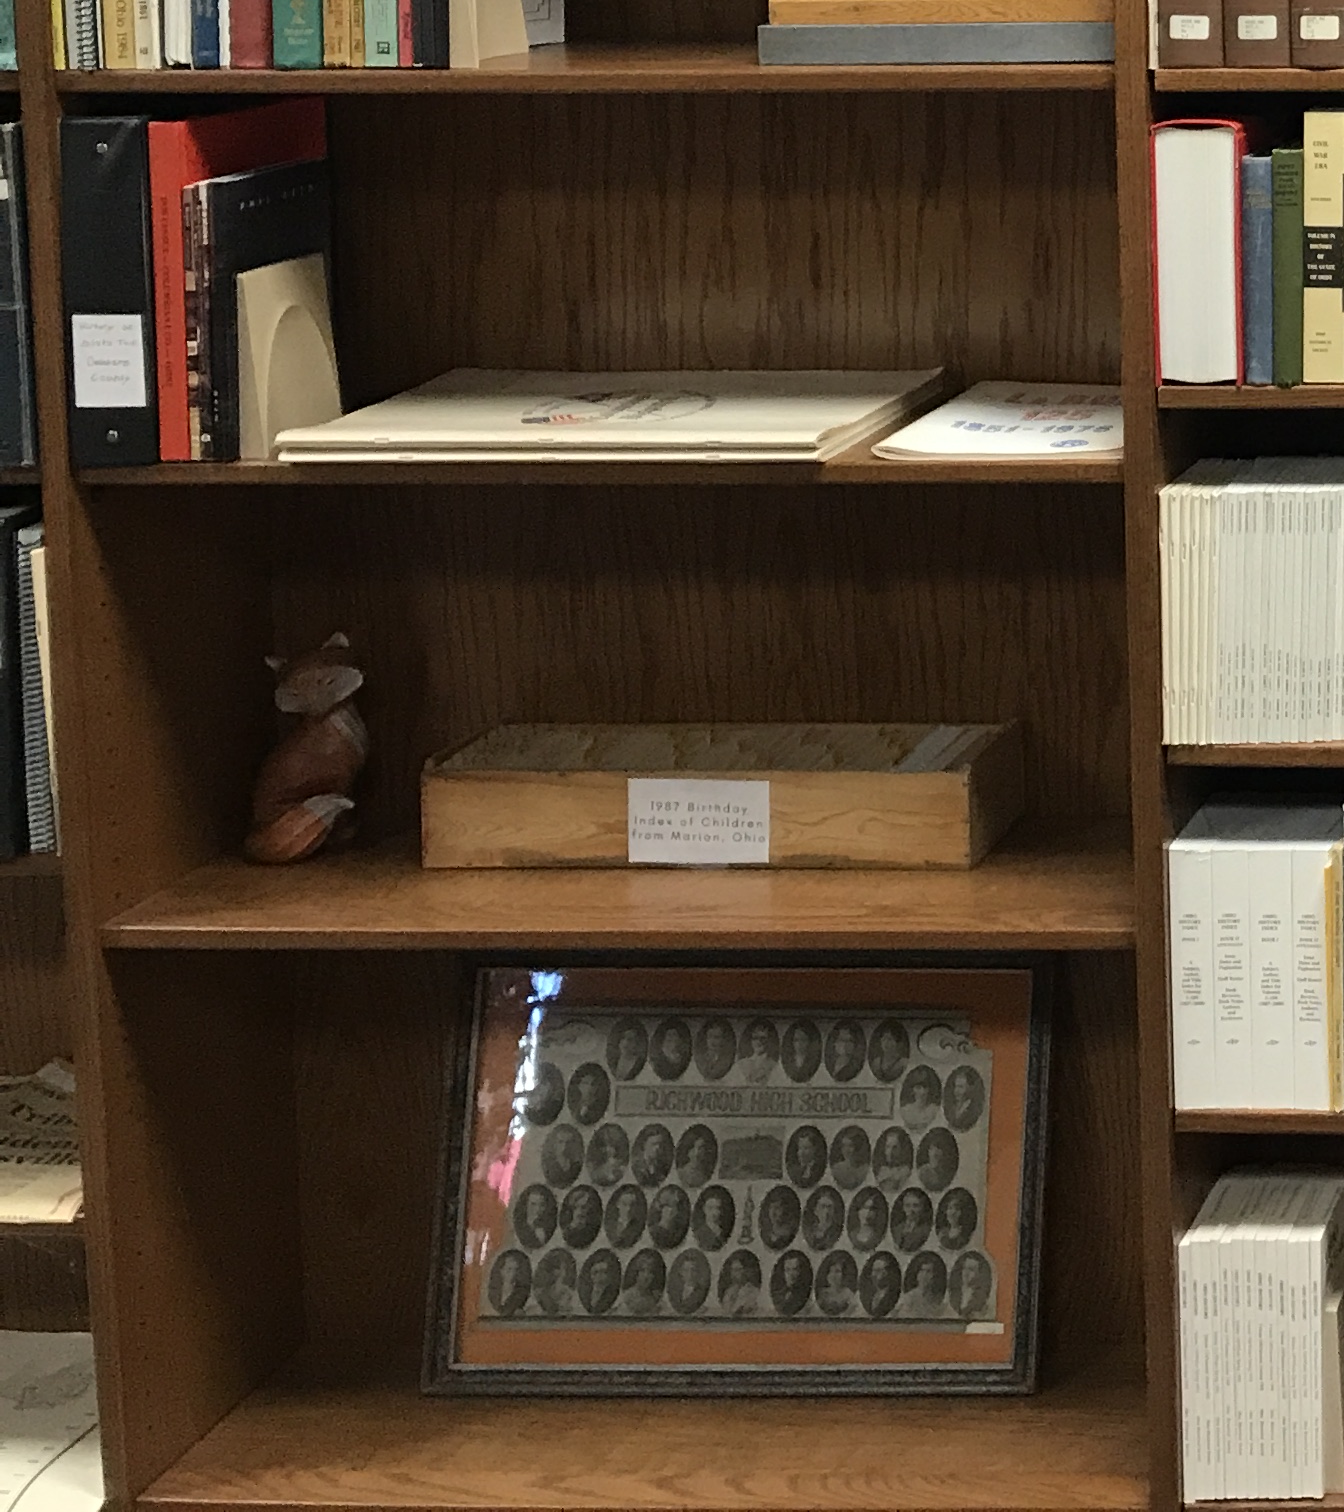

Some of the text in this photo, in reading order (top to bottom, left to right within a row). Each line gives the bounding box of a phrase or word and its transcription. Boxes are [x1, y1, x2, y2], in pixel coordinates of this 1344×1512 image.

[115, 0, 128, 27] Ohio
[116, 31, 128, 59] 1984
[650, 800, 748, 816] 1987 Birthday
[634, 814, 763, 829] Index of Children
[631, 828, 664, 840] from
[731, 831, 766, 843] Ohio
[645, 1087, 872, 1115] RICHWOOD HIGH SCHOOL
